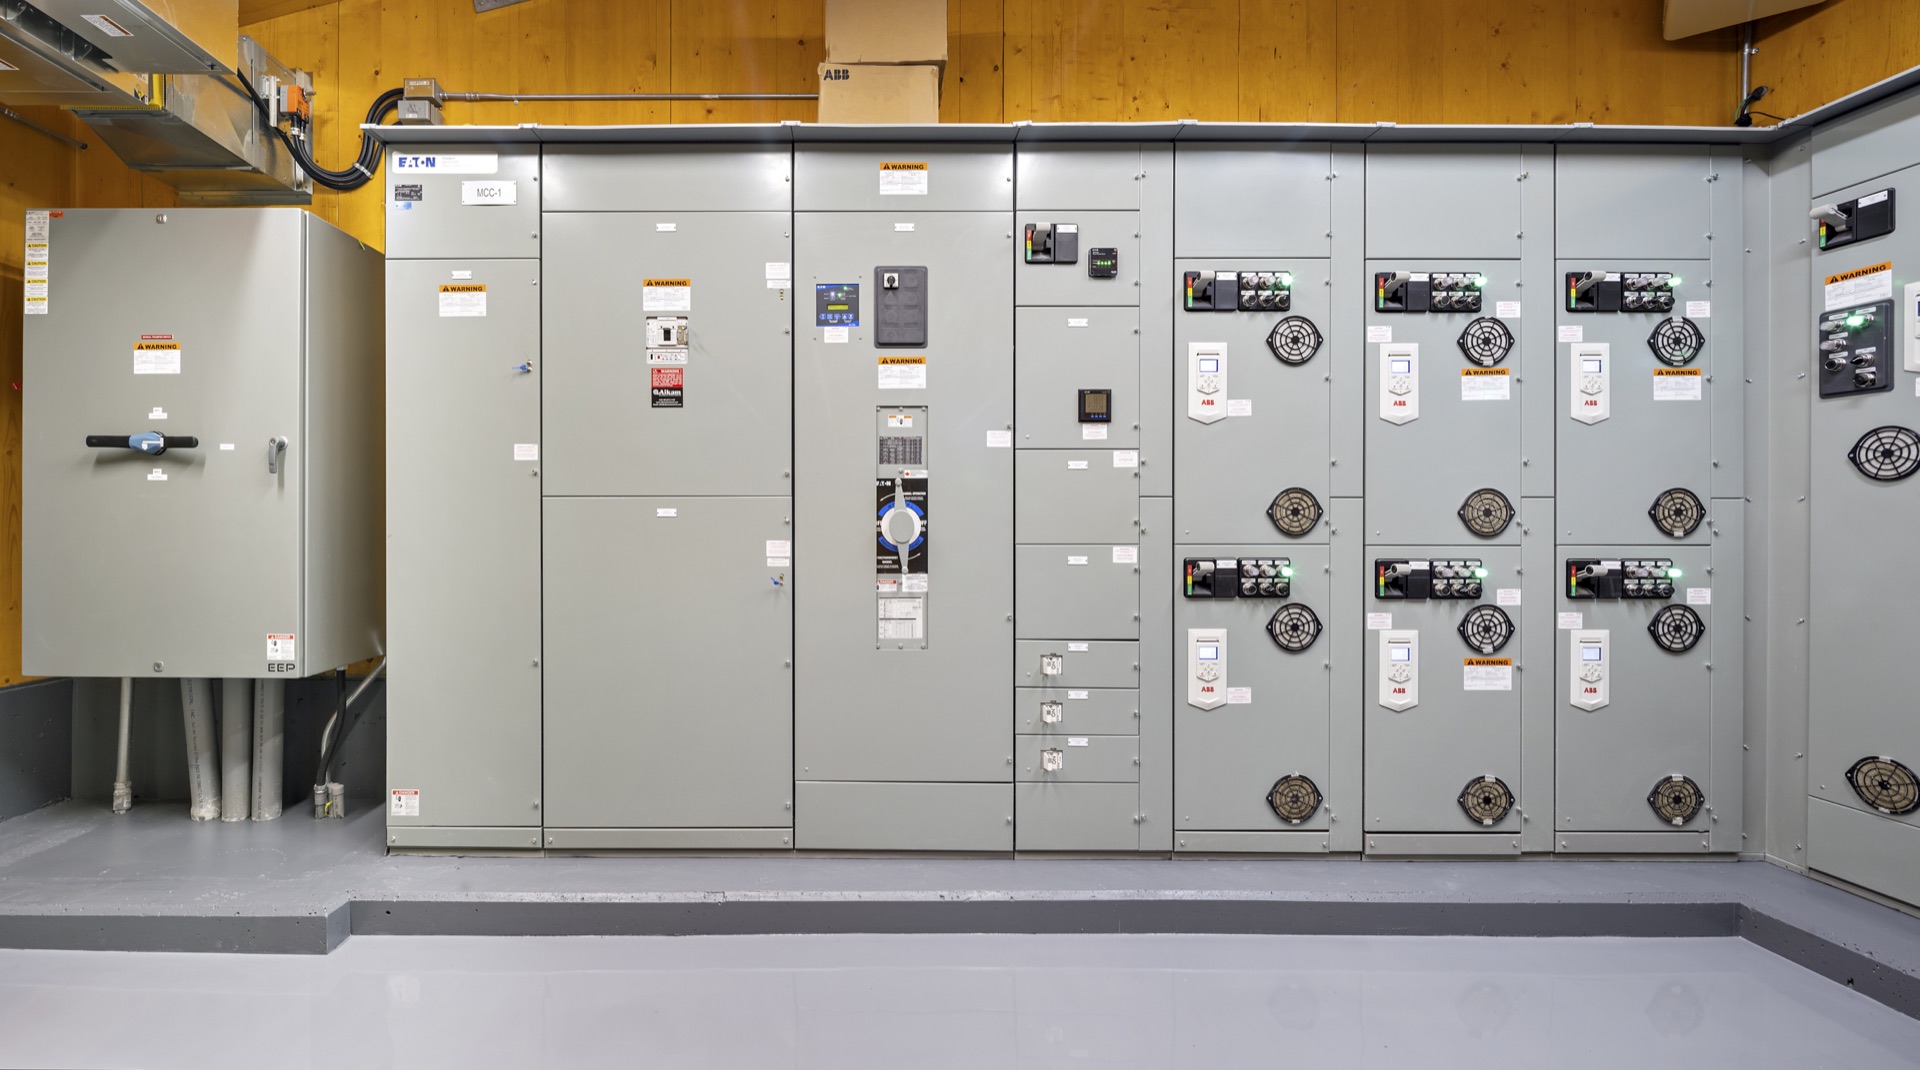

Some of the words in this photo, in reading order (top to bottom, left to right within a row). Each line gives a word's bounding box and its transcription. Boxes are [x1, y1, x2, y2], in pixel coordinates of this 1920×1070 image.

[823, 69, 850, 80] ABB
[476, 188, 502, 198] MCC-1
[1840, 264, 1887, 281] WARNING
[268, 663, 295, 672] EEP
